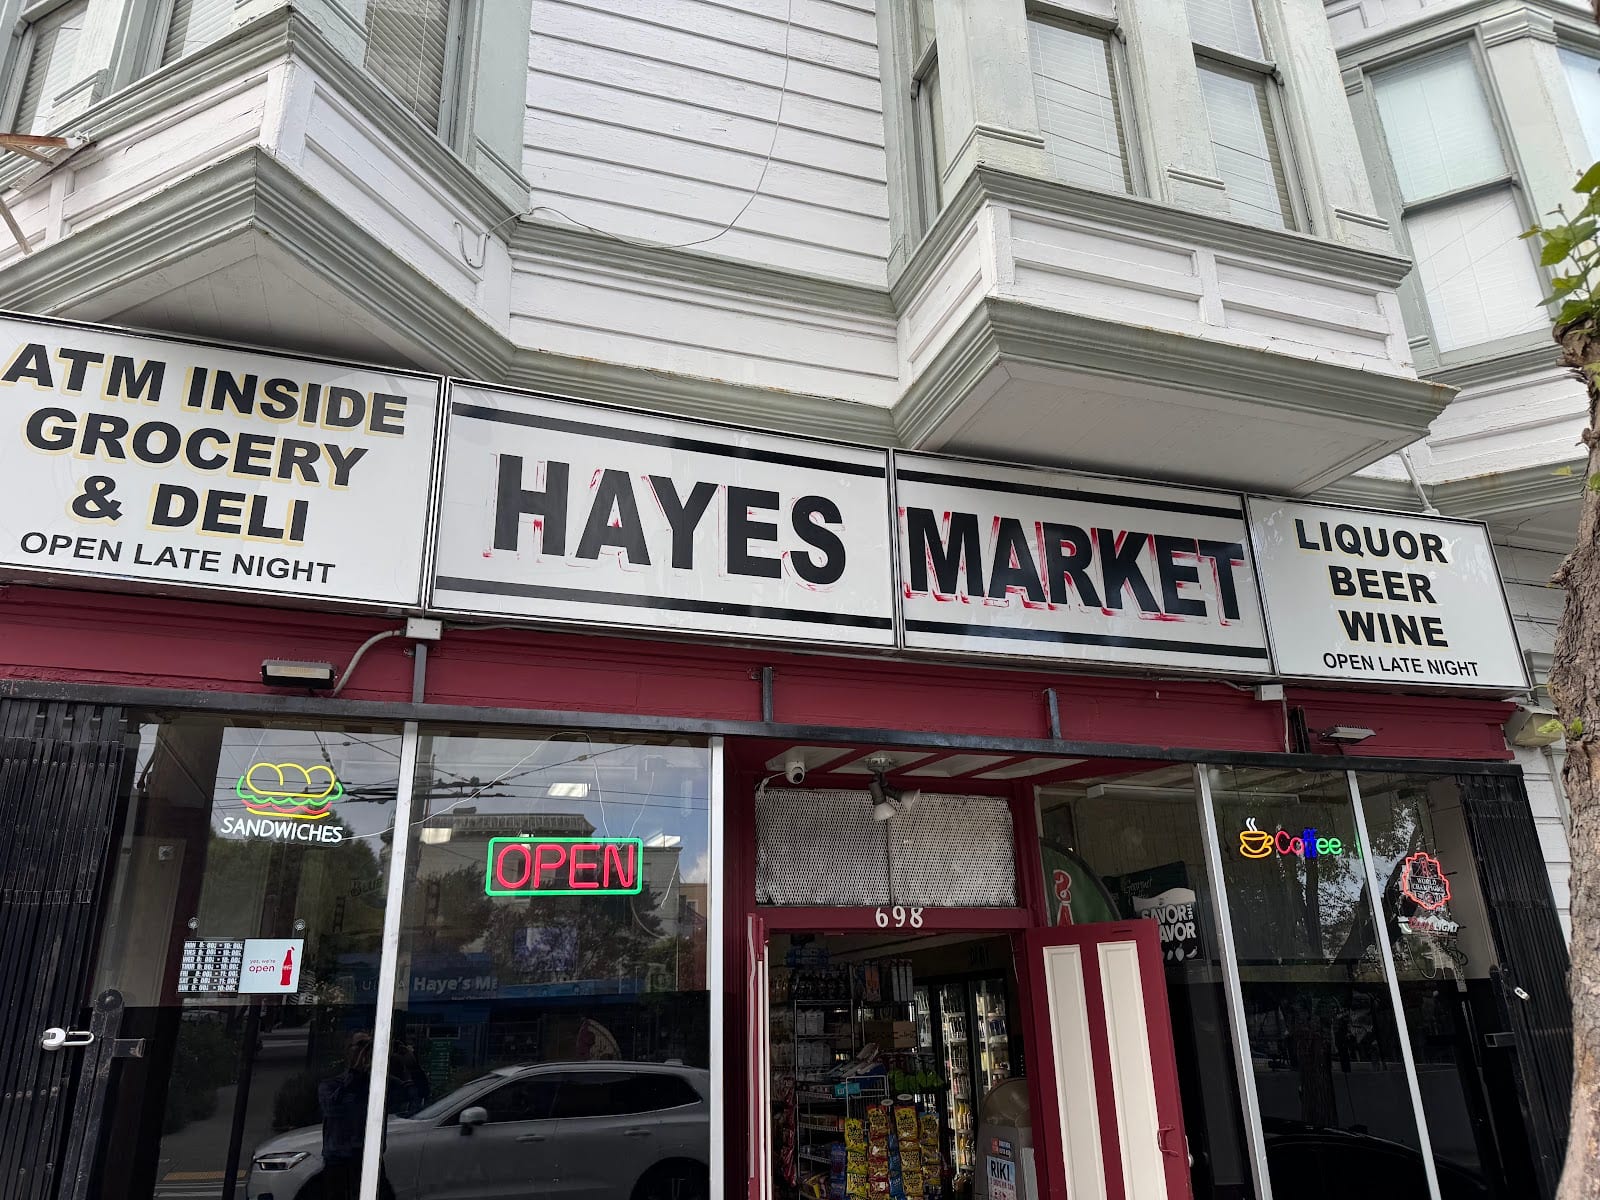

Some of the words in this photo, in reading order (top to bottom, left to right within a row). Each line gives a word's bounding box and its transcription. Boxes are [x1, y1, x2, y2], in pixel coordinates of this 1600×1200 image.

[1, 342, 167, 402] ATM
[185, 366, 409, 436] INSIDE
[25, 406, 369, 487] GROCERY
[71, 475, 124, 522] &
[150, 482, 310, 542] DELI
[492, 452, 847, 586] HAYES
[903, 506, 1245, 621] MARKET
[1294, 518, 1449, 564] LIQUOR
[20, 531, 123, 563] OPEN
[133, 543, 222, 573] LATE
[231, 553, 336, 584] NIGHT
[1328, 565, 1438, 604] BEER
[1338, 609, 1449, 648] WINE
[1323, 652, 1375, 672] OPEN
[1378, 656, 1424, 675] LATE
[1426, 659, 1479, 677] NIGHT
[220, 816, 344, 843] SANDWICHES
[1274, 827, 1342, 860] Coffee
[496, 843, 635, 889] OPEN
[875, 905, 925, 929] 698
[1141, 904, 1188, 925] SAVOR
[1159, 922, 1197, 943] AVOR
[249, 965, 275, 973] open
[991, 1160, 1010, 1182] RIKI
